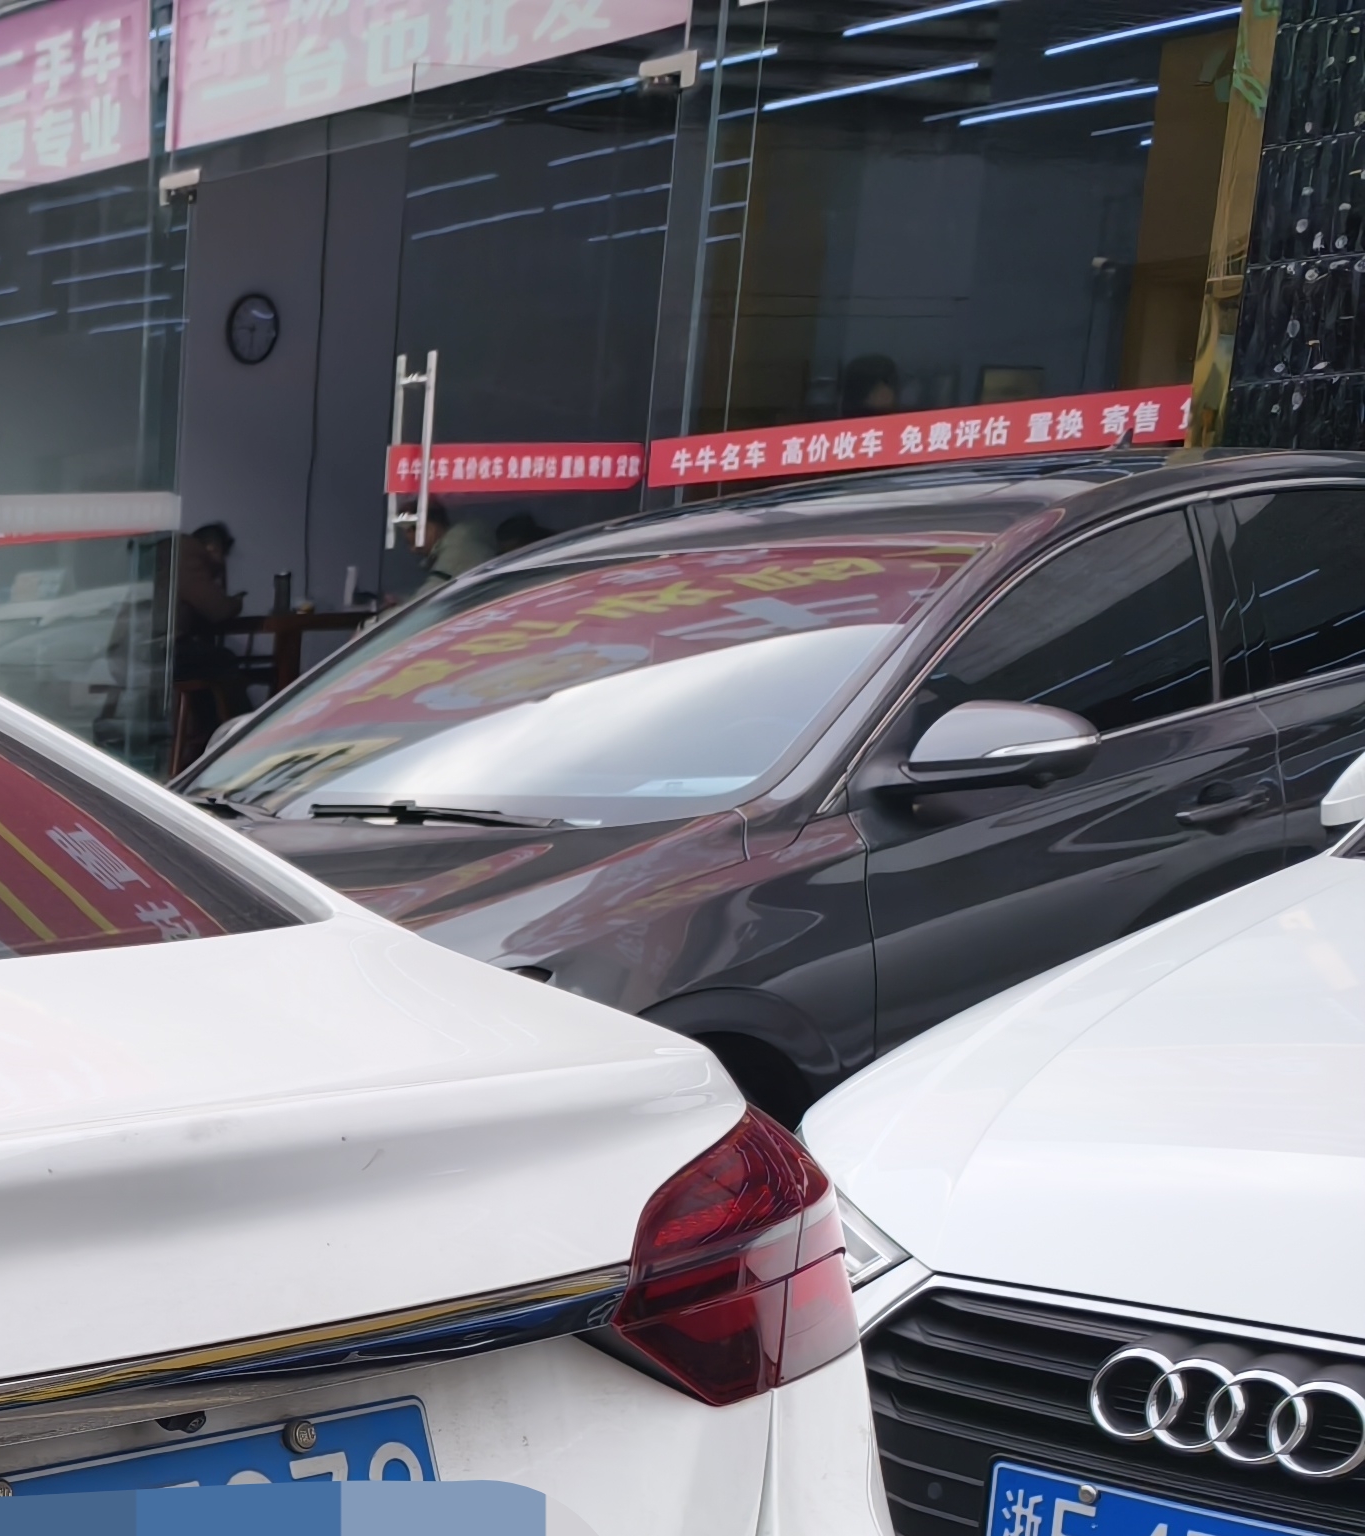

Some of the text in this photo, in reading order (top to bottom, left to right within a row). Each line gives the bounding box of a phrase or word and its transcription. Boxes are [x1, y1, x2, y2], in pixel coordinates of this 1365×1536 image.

[671, 440, 766, 473] 牛牛名车
[782, 428, 884, 465] 高价收车
[899, 417, 1011, 456] 免费评估
[1027, 409, 1084, 443] 置换
[1100, 400, 1161, 435] 寄售
